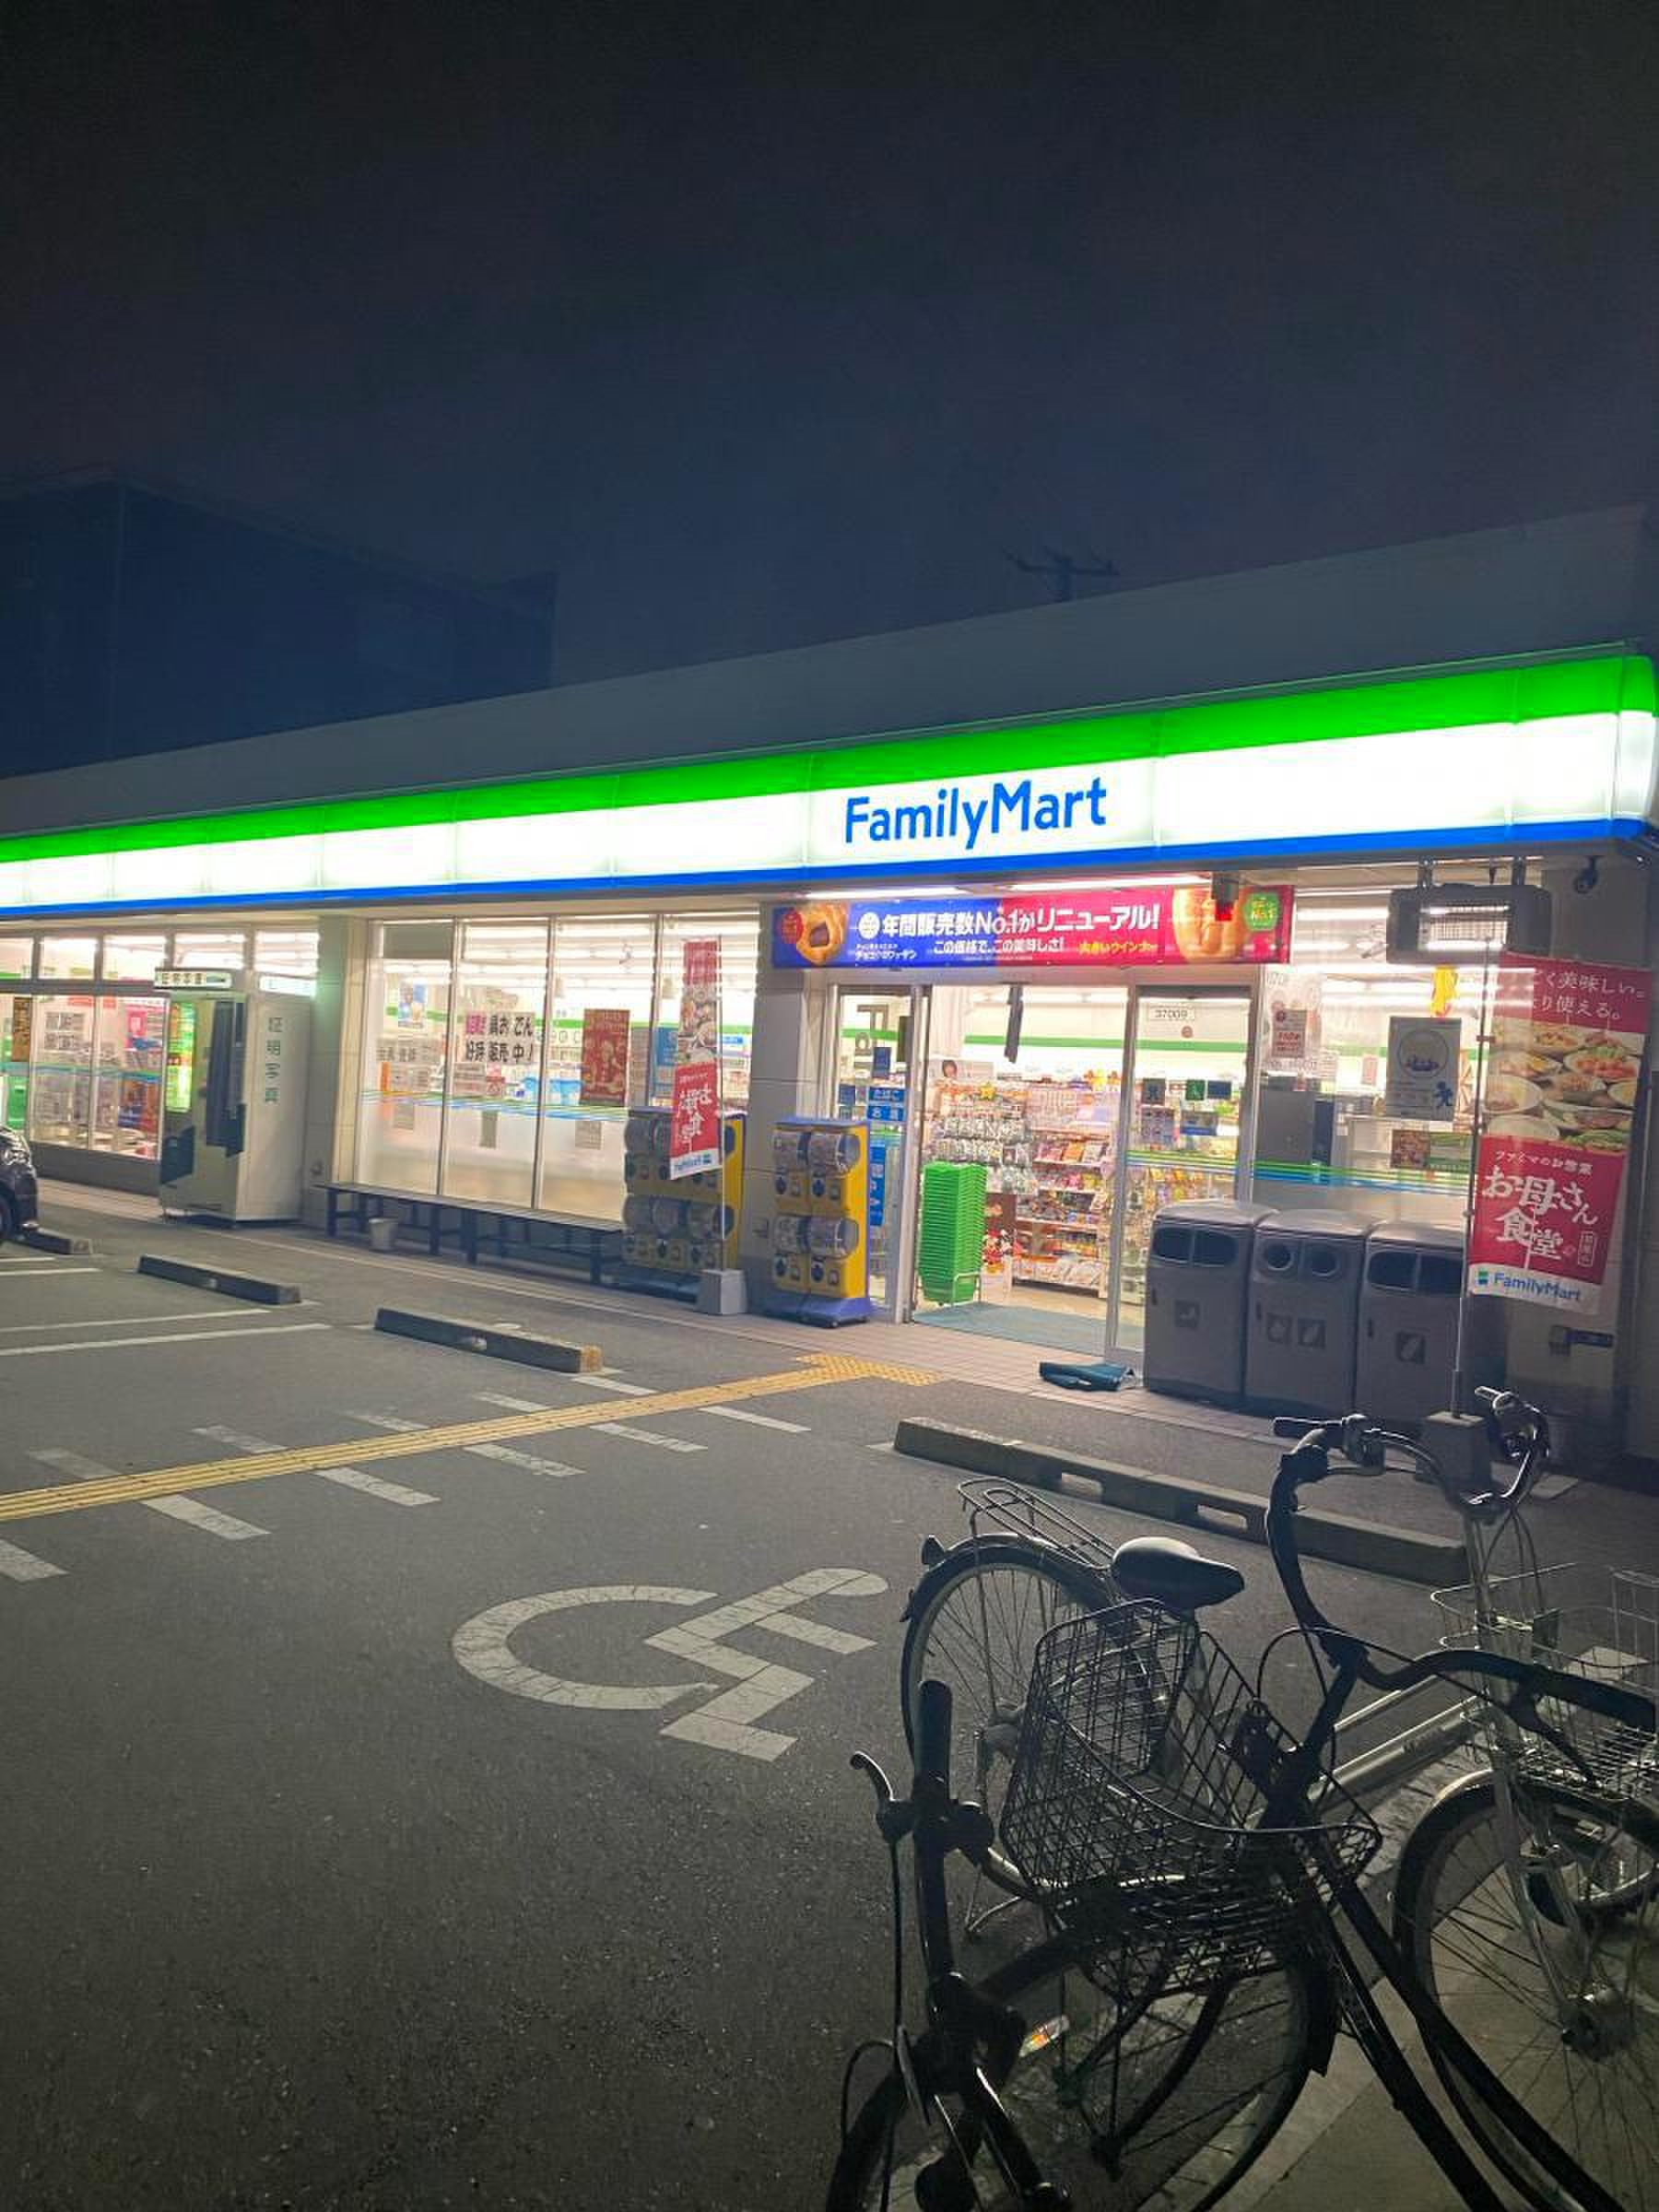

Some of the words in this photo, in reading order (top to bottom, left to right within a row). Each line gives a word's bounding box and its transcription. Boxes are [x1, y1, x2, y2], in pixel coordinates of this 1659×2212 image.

[845, 777, 1107, 850] FamilyMart
[1482, 1165, 1598, 1226] お母さん
[1494, 1207, 1565, 1260] 食堂
[1494, 1272, 1582, 1301] FamilyMart
